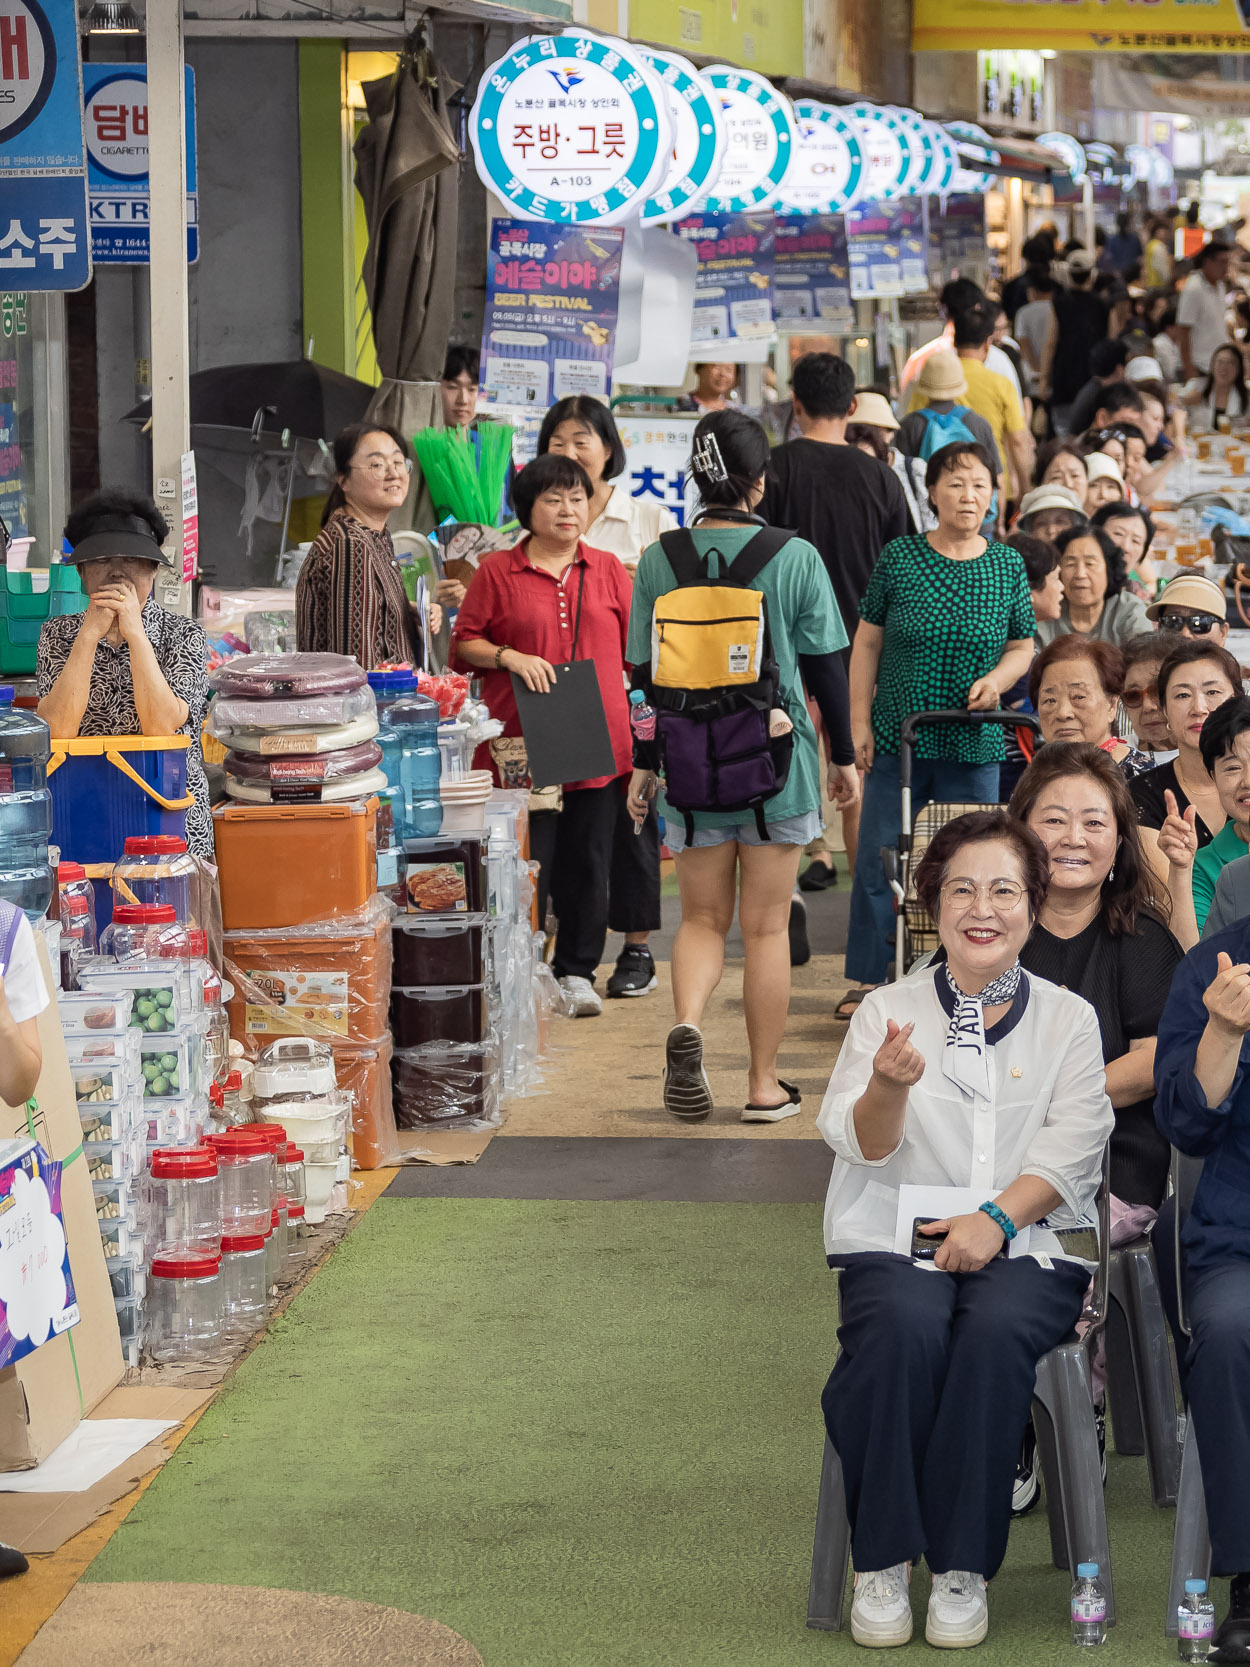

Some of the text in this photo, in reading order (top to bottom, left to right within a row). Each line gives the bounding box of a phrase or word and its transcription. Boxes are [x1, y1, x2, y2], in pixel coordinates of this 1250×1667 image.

[515, 98, 620, 109] 노룬산 골목시장 상인회
[512, 122, 626, 159] 주방·그릇
[550, 176, 592, 186] A-103
[90, 201, 149, 219] KTR
[0, 218, 77, 270] 소주
[257, 978, 278, 989] 20L
[957, 1000, 982, 1056] J'ADI
